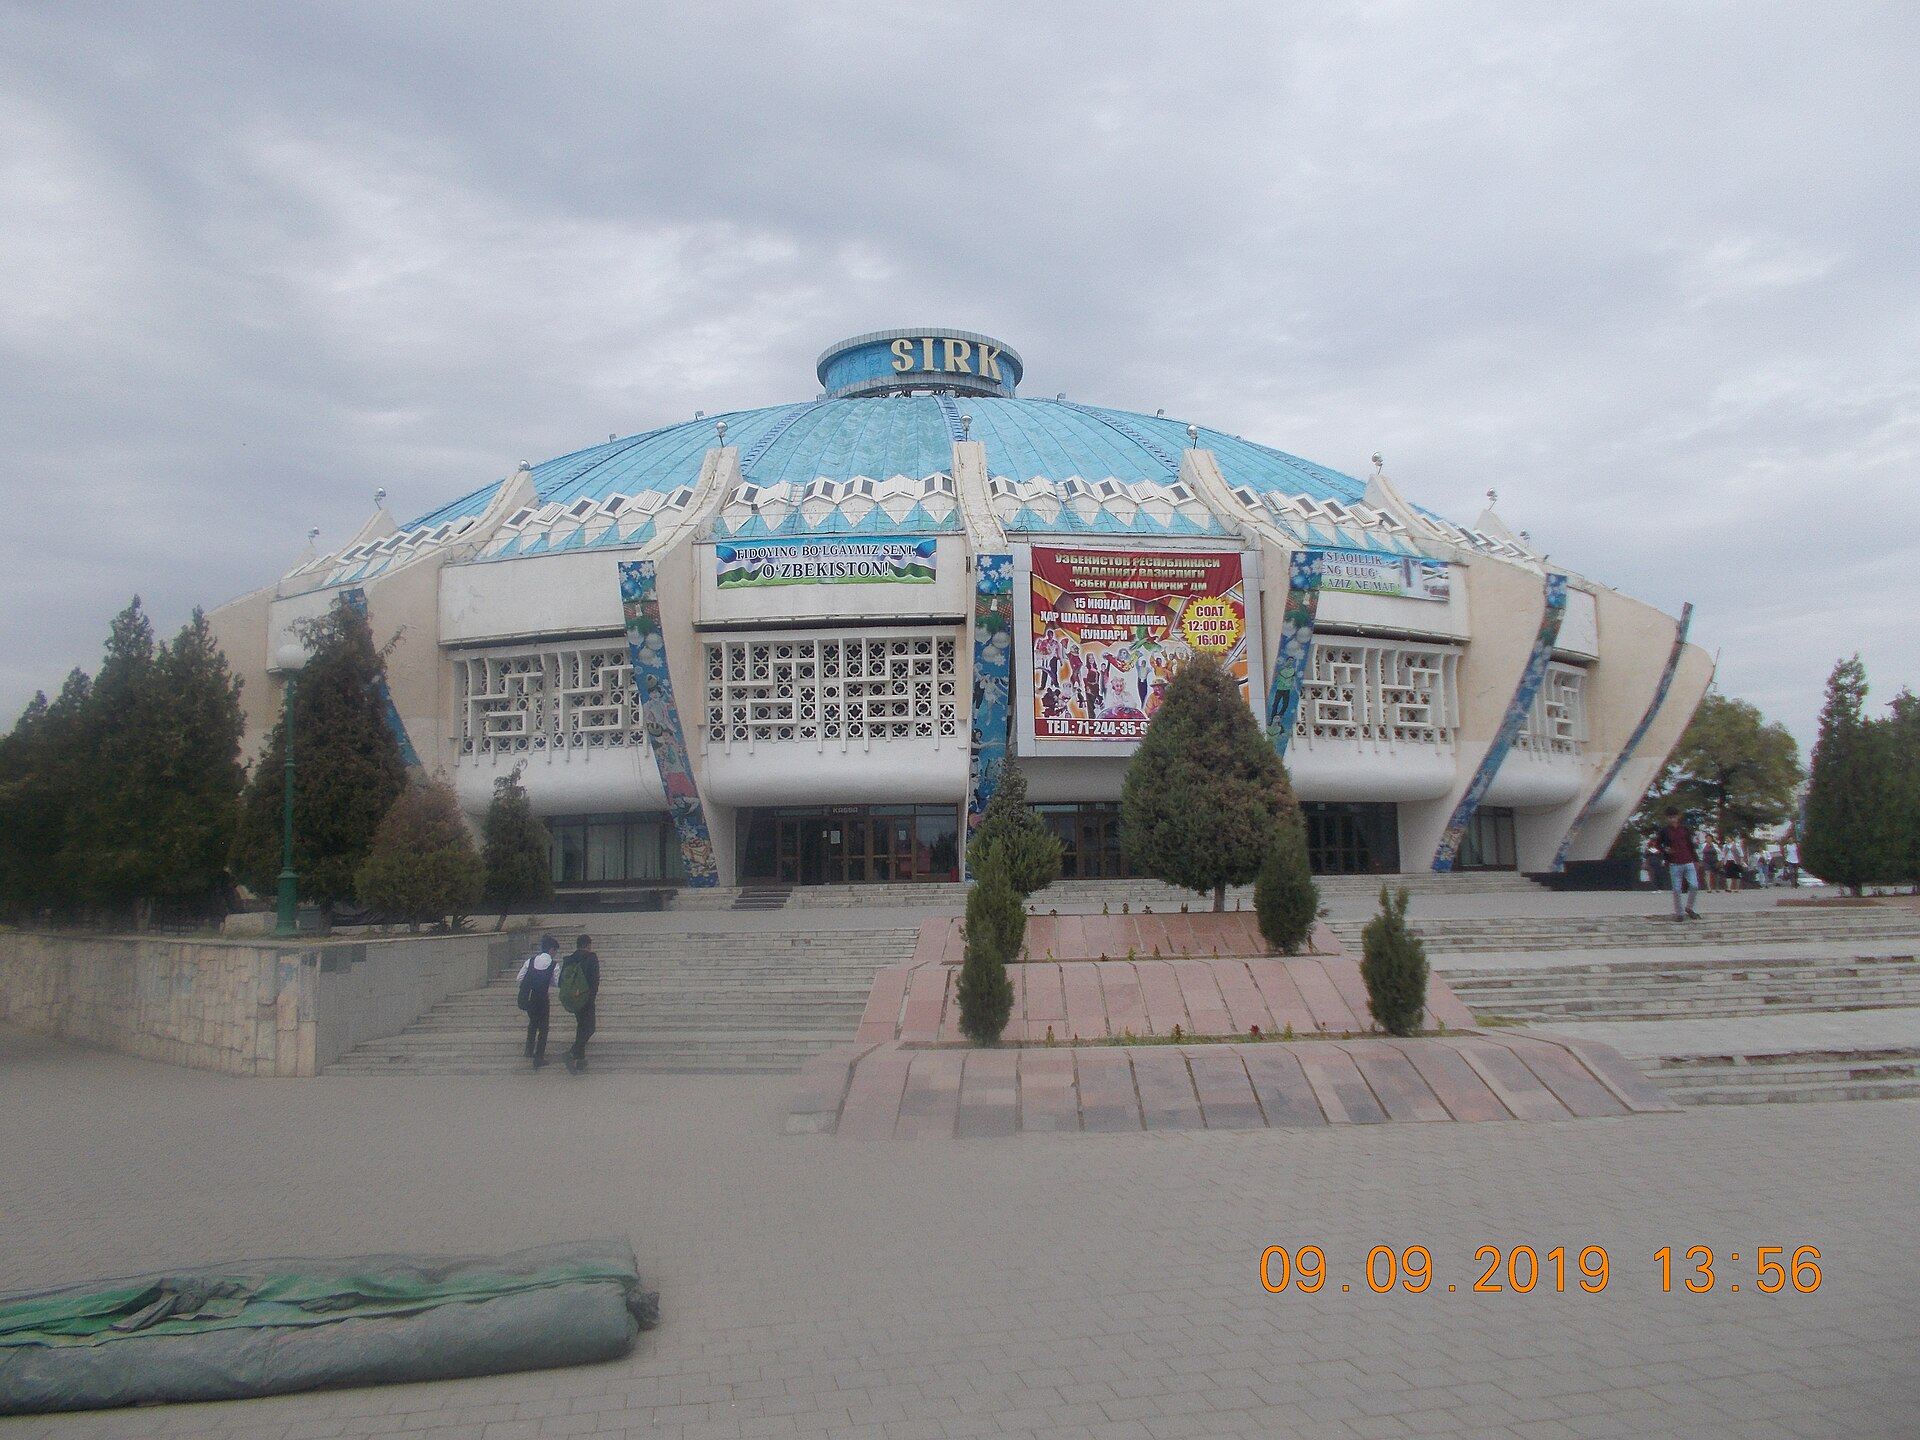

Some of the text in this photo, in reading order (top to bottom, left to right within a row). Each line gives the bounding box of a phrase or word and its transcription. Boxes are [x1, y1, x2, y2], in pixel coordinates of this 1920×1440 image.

[890, 338, 1002, 380] SIRK
[736, 546, 798, 560] FIDOYING
[762, 561, 890, 578] O'ZBEKISTON!
[1139, 568, 1205, 579] ВАЗИРЛИГИ
[1108, 580, 1149, 590] ДАВЛАТ
[1328, 578, 1352, 589] AZIZ
[1074, 598, 1131, 611] 15 ИЮНДАН
[1196, 606, 1224, 617] СОАТ
[1060, 613, 1099, 624] ШАНБА
[1101, 614, 1114, 625] ВА
[1116, 615, 1167, 626] ЯКШАНБА
[1187, 620, 1234, 631] 12:00 ВА
[1196, 634, 1227, 646] 16:00
[1077, 721, 1150, 735] 71-244-35-9
